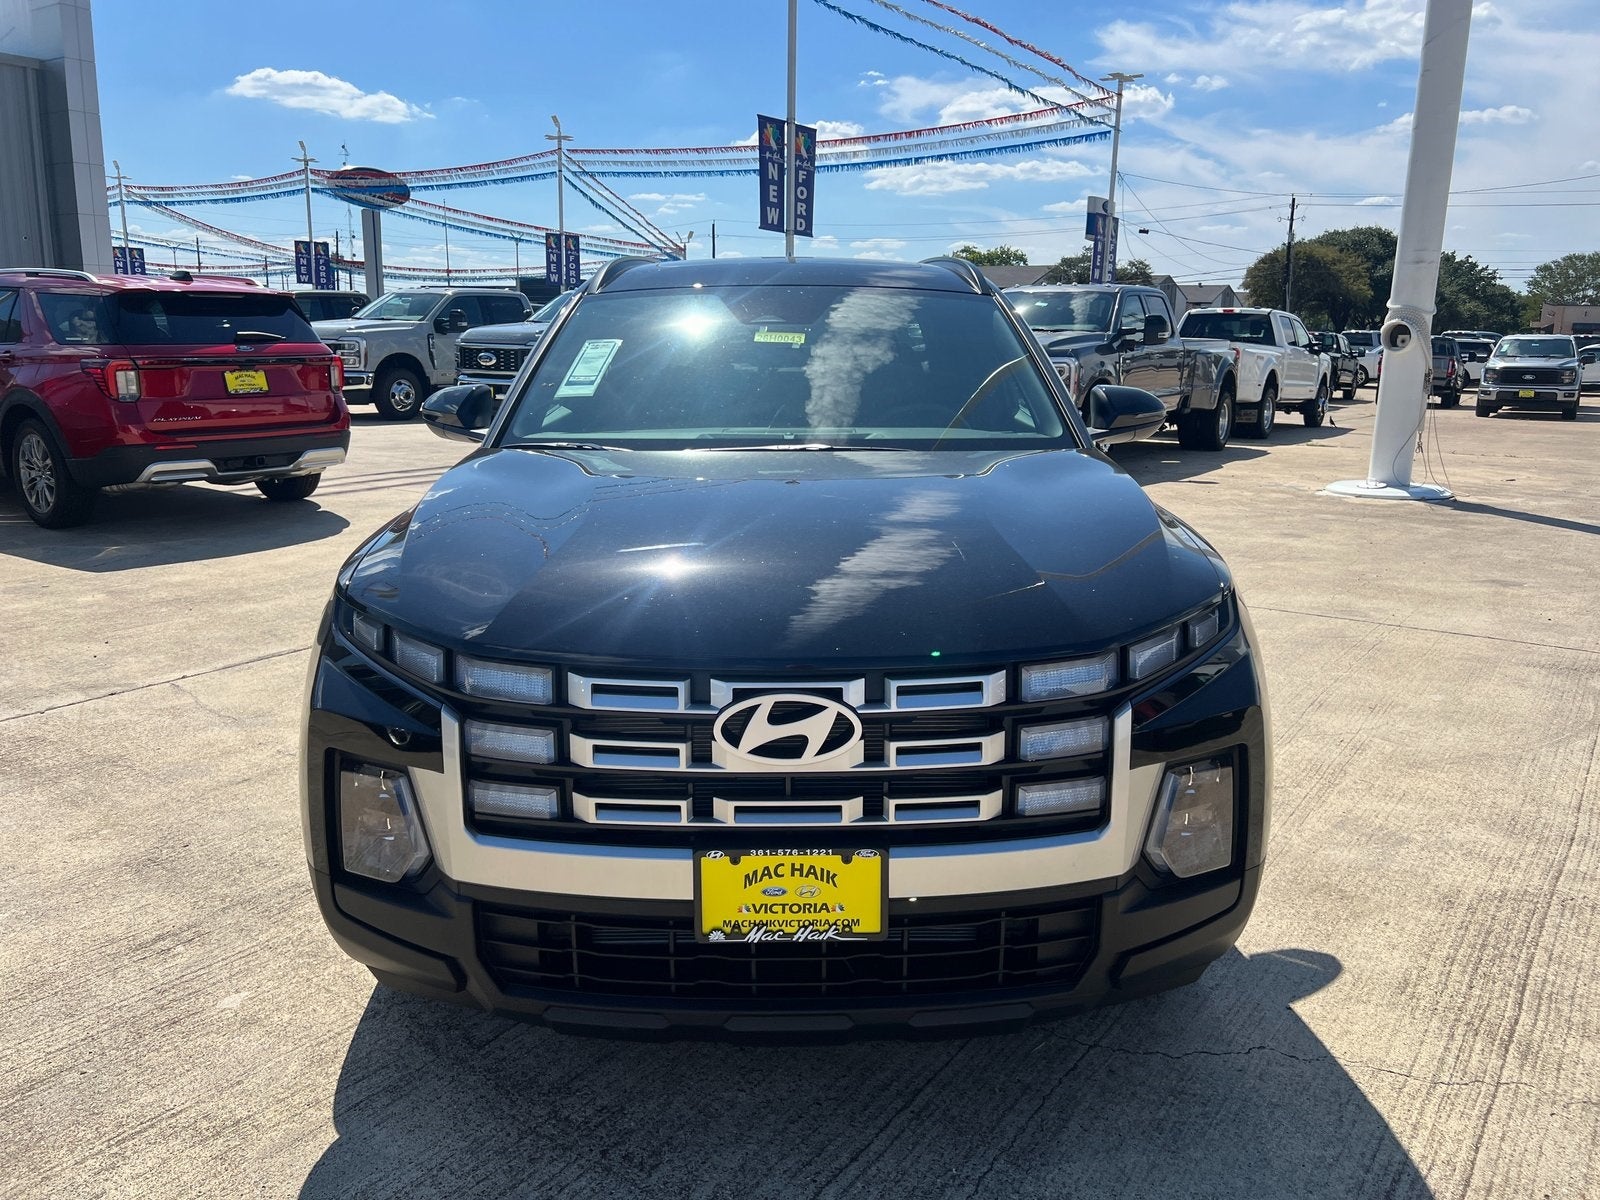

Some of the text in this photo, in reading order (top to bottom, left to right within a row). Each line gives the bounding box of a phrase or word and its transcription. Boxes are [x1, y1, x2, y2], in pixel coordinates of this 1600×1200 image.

[767, 162, 779, 225] NEW
[796, 170, 808, 231] FORD
[300, 257, 309, 282] NEW
[319, 259, 327, 284] FORD
[550, 253, 558, 282] NEW
[743, 863, 838, 889] MAC HAIK
[751, 903, 831, 914] VICTORIA
[722, 918, 860, 928] MACHAIKVICTORIA.COM
[745, 926, 841, 943] Mac Haik
